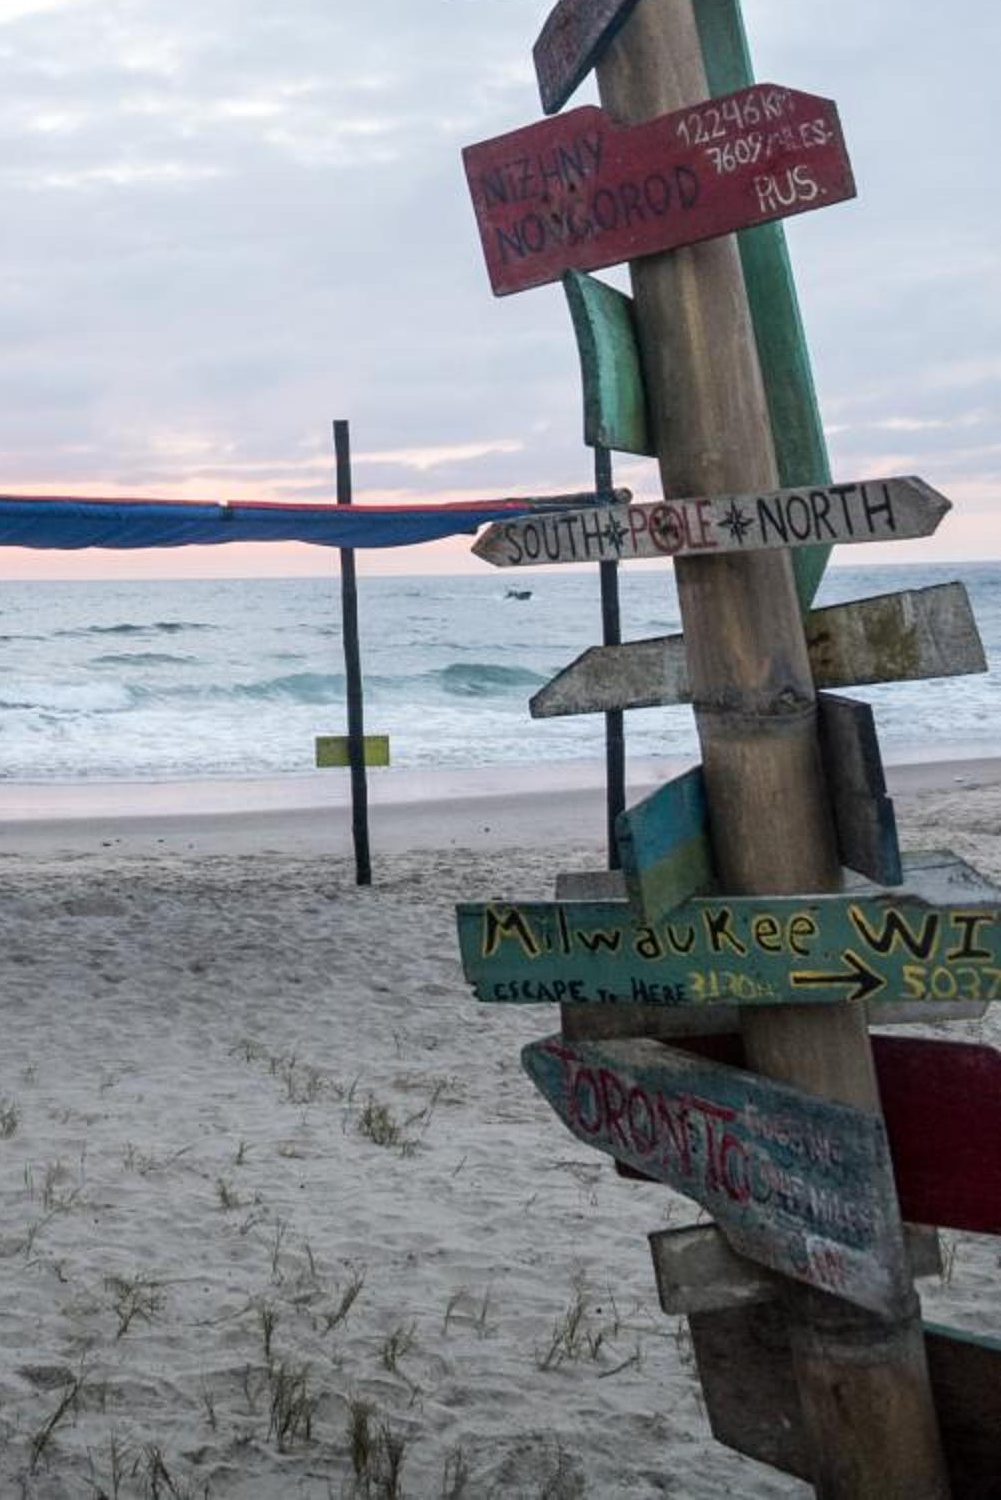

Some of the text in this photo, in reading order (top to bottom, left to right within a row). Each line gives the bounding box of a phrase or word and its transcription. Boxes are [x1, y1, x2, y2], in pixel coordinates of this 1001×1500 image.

[676, 97, 759, 148] 12246
[706, 131, 762, 174] 7609
[504, 484, 897, 564] SOUTH POLE NORTH
[849, 902, 997, 962] WI
